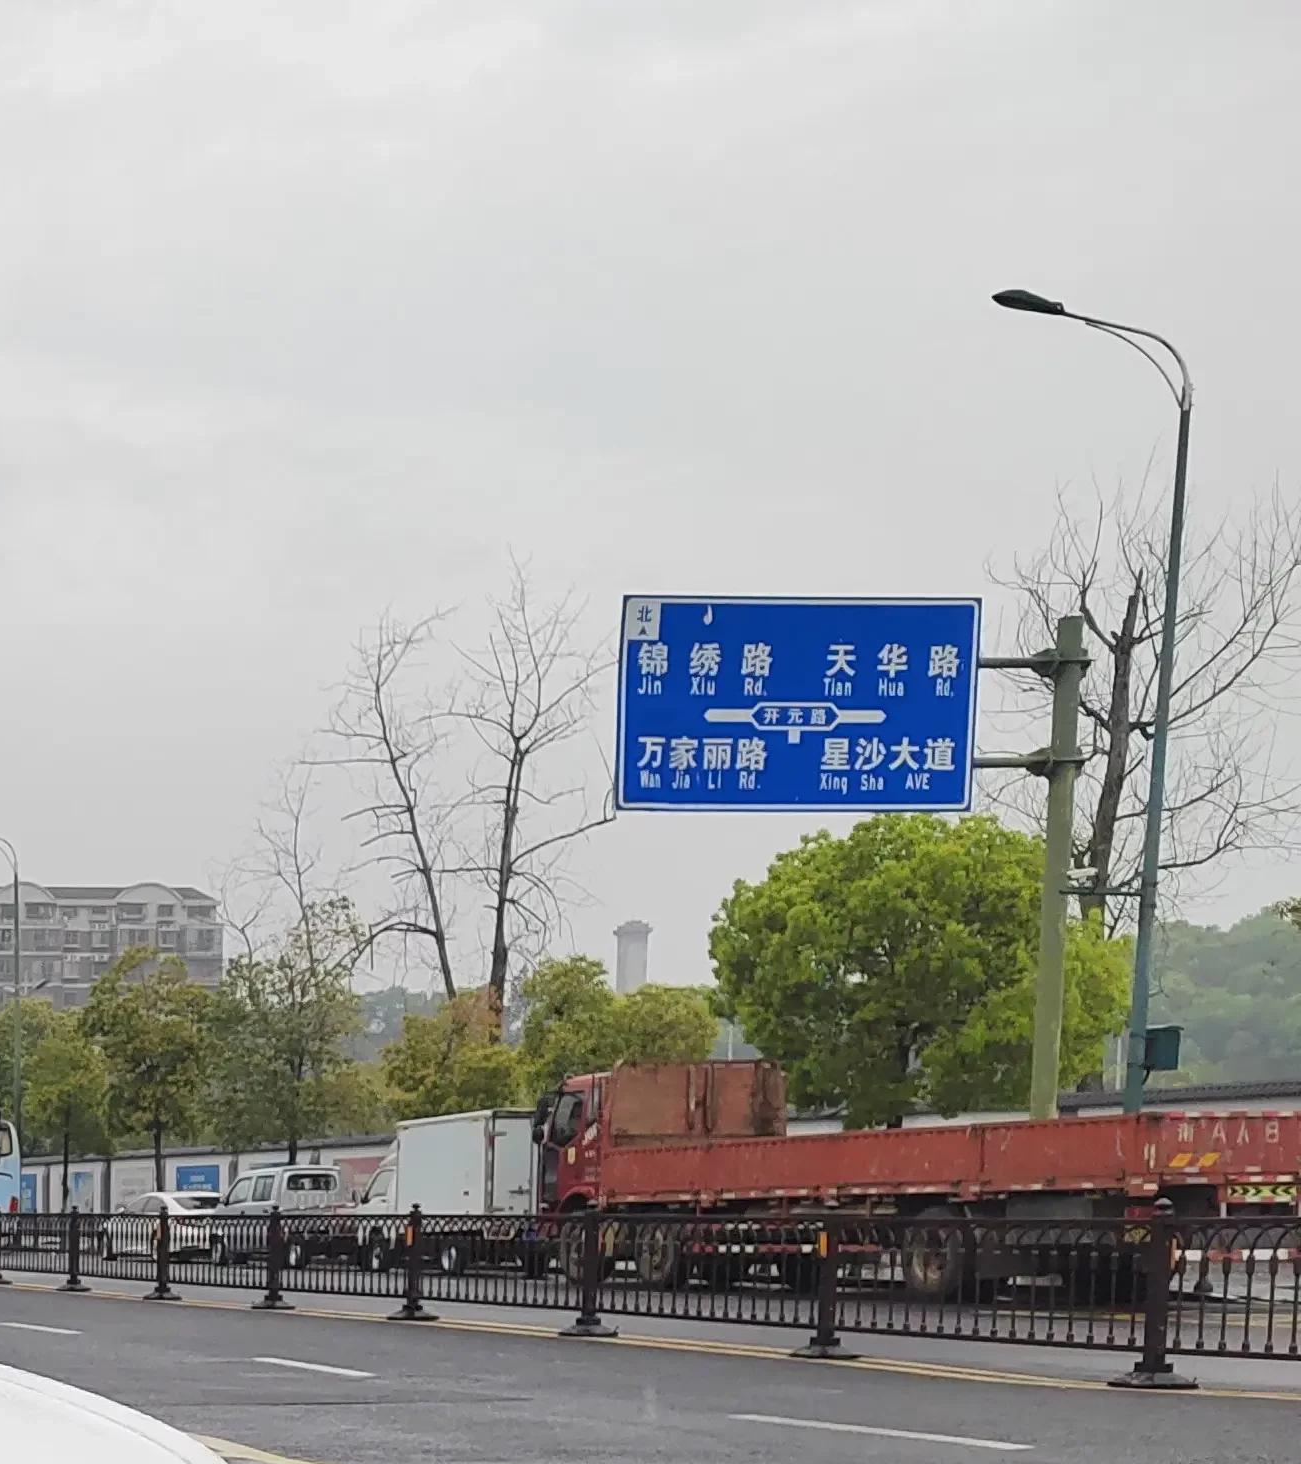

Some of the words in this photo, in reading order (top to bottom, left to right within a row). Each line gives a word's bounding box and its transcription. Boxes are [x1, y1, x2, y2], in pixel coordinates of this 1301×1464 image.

[636, 605, 652, 622] 北
[637, 642, 773, 677] 锦绣路
[825, 643, 960, 678] 天华路
[637, 676, 662, 695] Jin
[689, 676, 716, 696] Xiu
[823, 677, 853, 697] Tian
[878, 677, 905, 697] Hua
[763, 708, 827, 725] 开元路
[637, 736, 768, 771] 万家丽路
[820, 736, 956, 771] 星沙大道
[640, 769, 661, 789] Wan
[671, 769, 691, 789] Jia
[708, 769, 722, 789] Li
[819, 772, 848, 795] Xing
[860, 773, 884, 791] Sha
[905, 773, 931, 790] AVE
